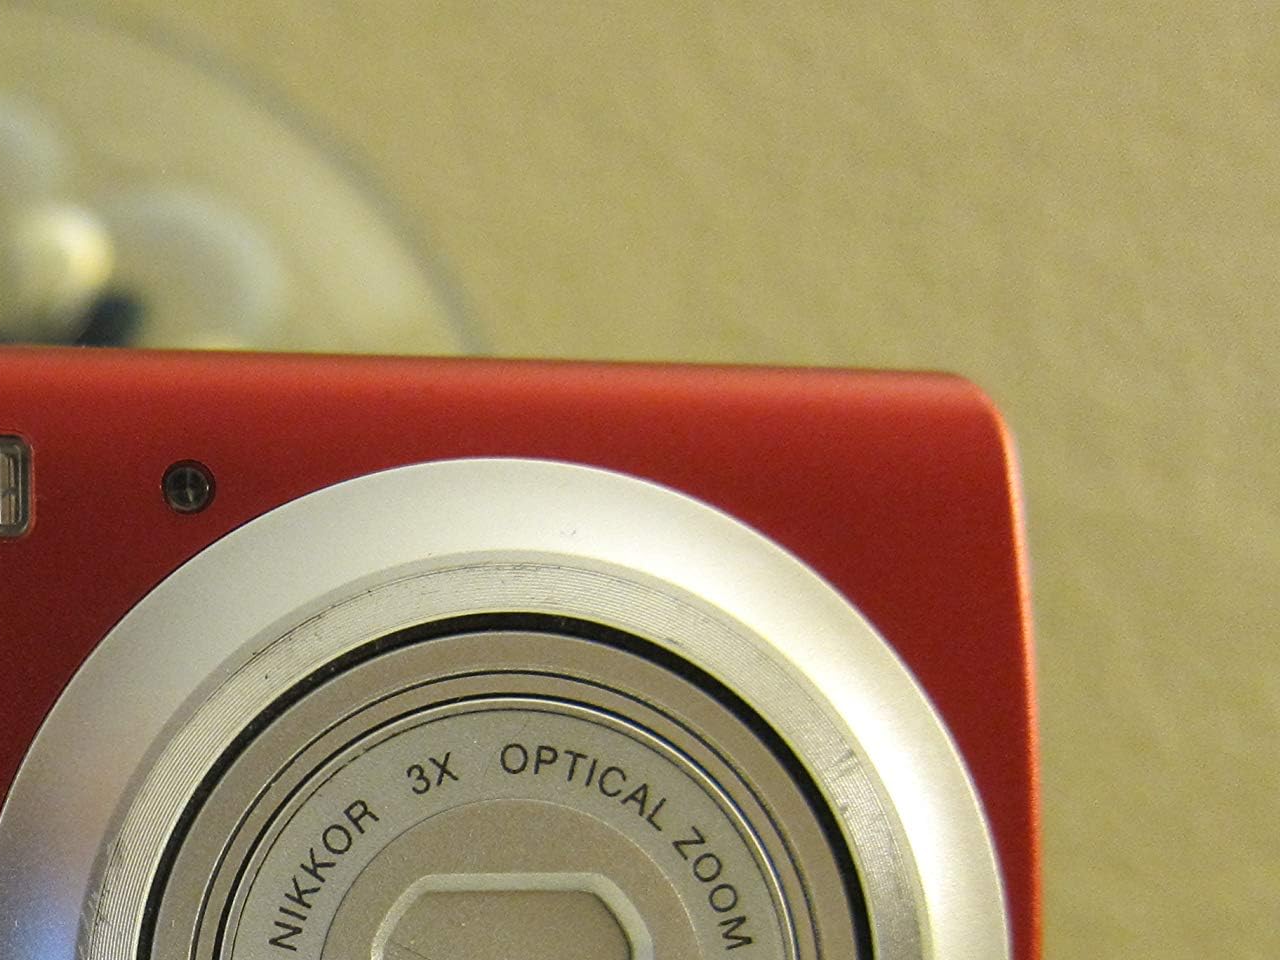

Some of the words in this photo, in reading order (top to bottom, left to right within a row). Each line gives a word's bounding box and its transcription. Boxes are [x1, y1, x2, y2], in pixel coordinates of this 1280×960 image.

[269, 799, 380, 952] NIKKOR
[406, 751, 460, 796] 3X
[499, 743, 667, 832] OPTICAL
[673, 827, 753, 951] ZOOM
